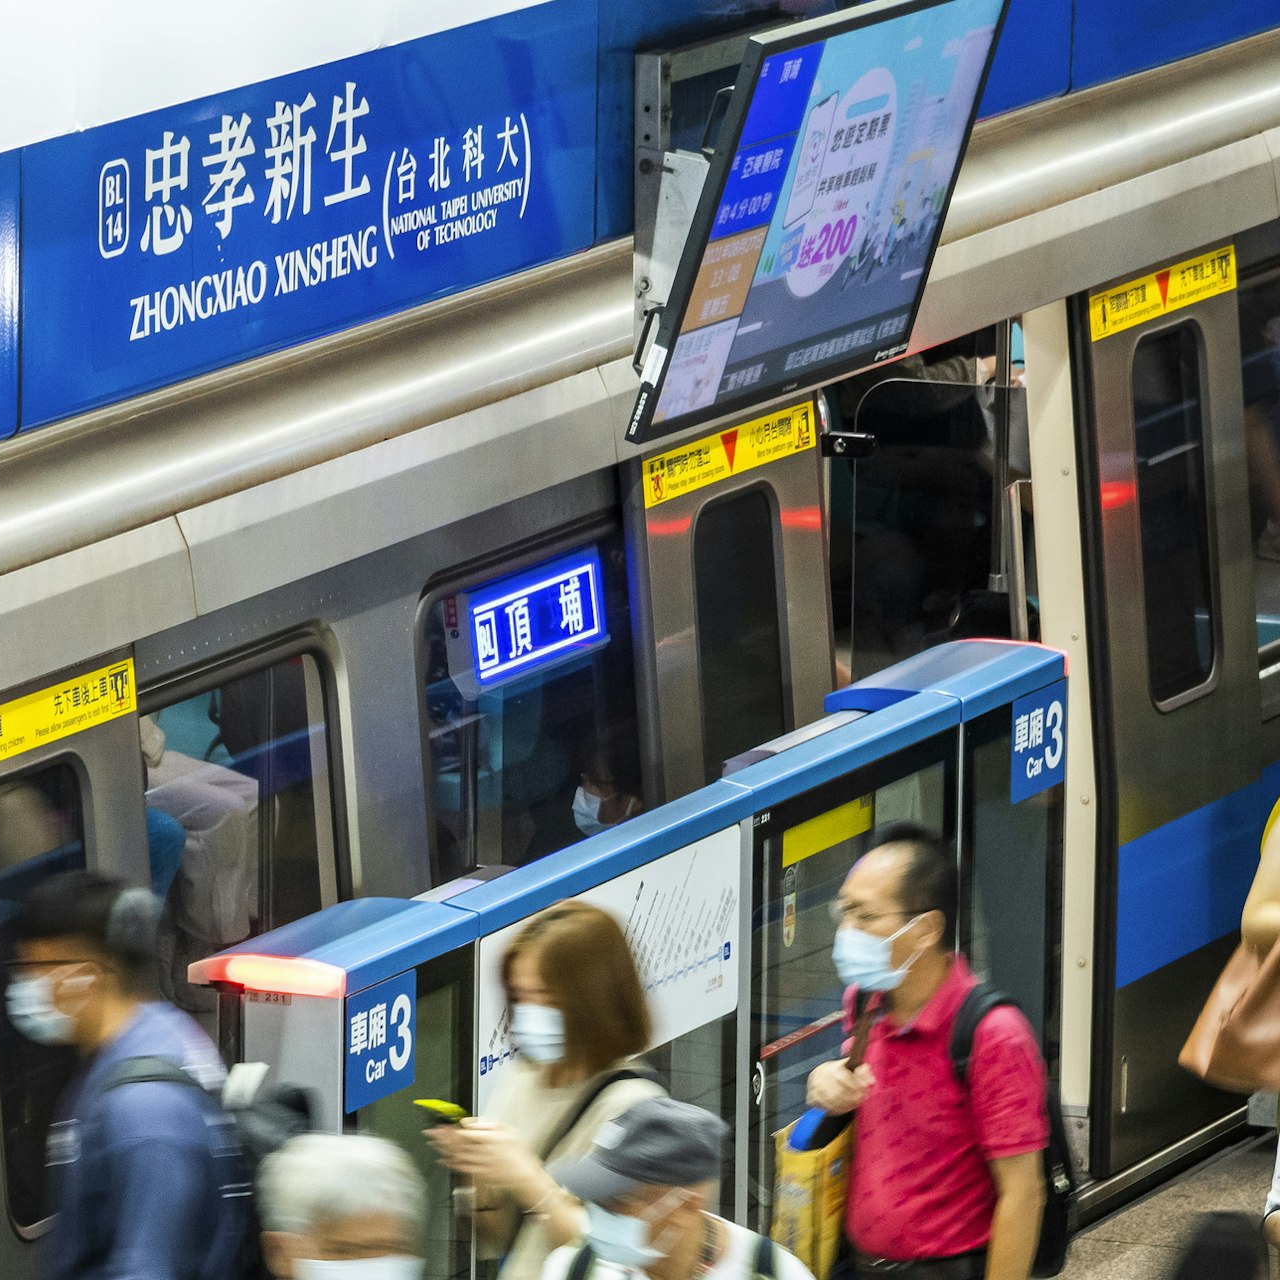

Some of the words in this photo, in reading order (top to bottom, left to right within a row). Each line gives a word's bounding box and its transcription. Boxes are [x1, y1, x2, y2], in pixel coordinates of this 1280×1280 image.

[140, 81, 371, 256] 忠孝新生
[105, 173, 124, 207] BL
[391, 205, 437, 236] NATIONAL
[441, 194, 468, 221] TAIPEI
[471, 177, 524, 213] UNIVERSITY
[106, 214, 122, 245] 14
[416, 230, 431, 252] OF
[434, 208, 498, 246] TECHNOLOGY
[130, 260, 267, 341] ZHONGXIAO
[274, 226, 378, 296] XINSHENG
[504, 576, 584, 659] 頂埔
[478, 623, 496, 660] BL
[53, 676, 108, 717] 先下車後上車
[8, 736, 25, 750] children
[35, 727, 50, 739] Please
[50, 722, 61, 734] allow
[62, 714, 87, 731] passengers
[1014, 707, 1044, 753] 車廂
[1045, 700, 1063, 769] 3
[1026, 756, 1044, 779] Car
[265, 992, 285, 1003] 231
[350, 1002, 387, 1055] 車廂
[389, 994, 412, 1071] 3
[365, 1058, 387, 1083] Car
